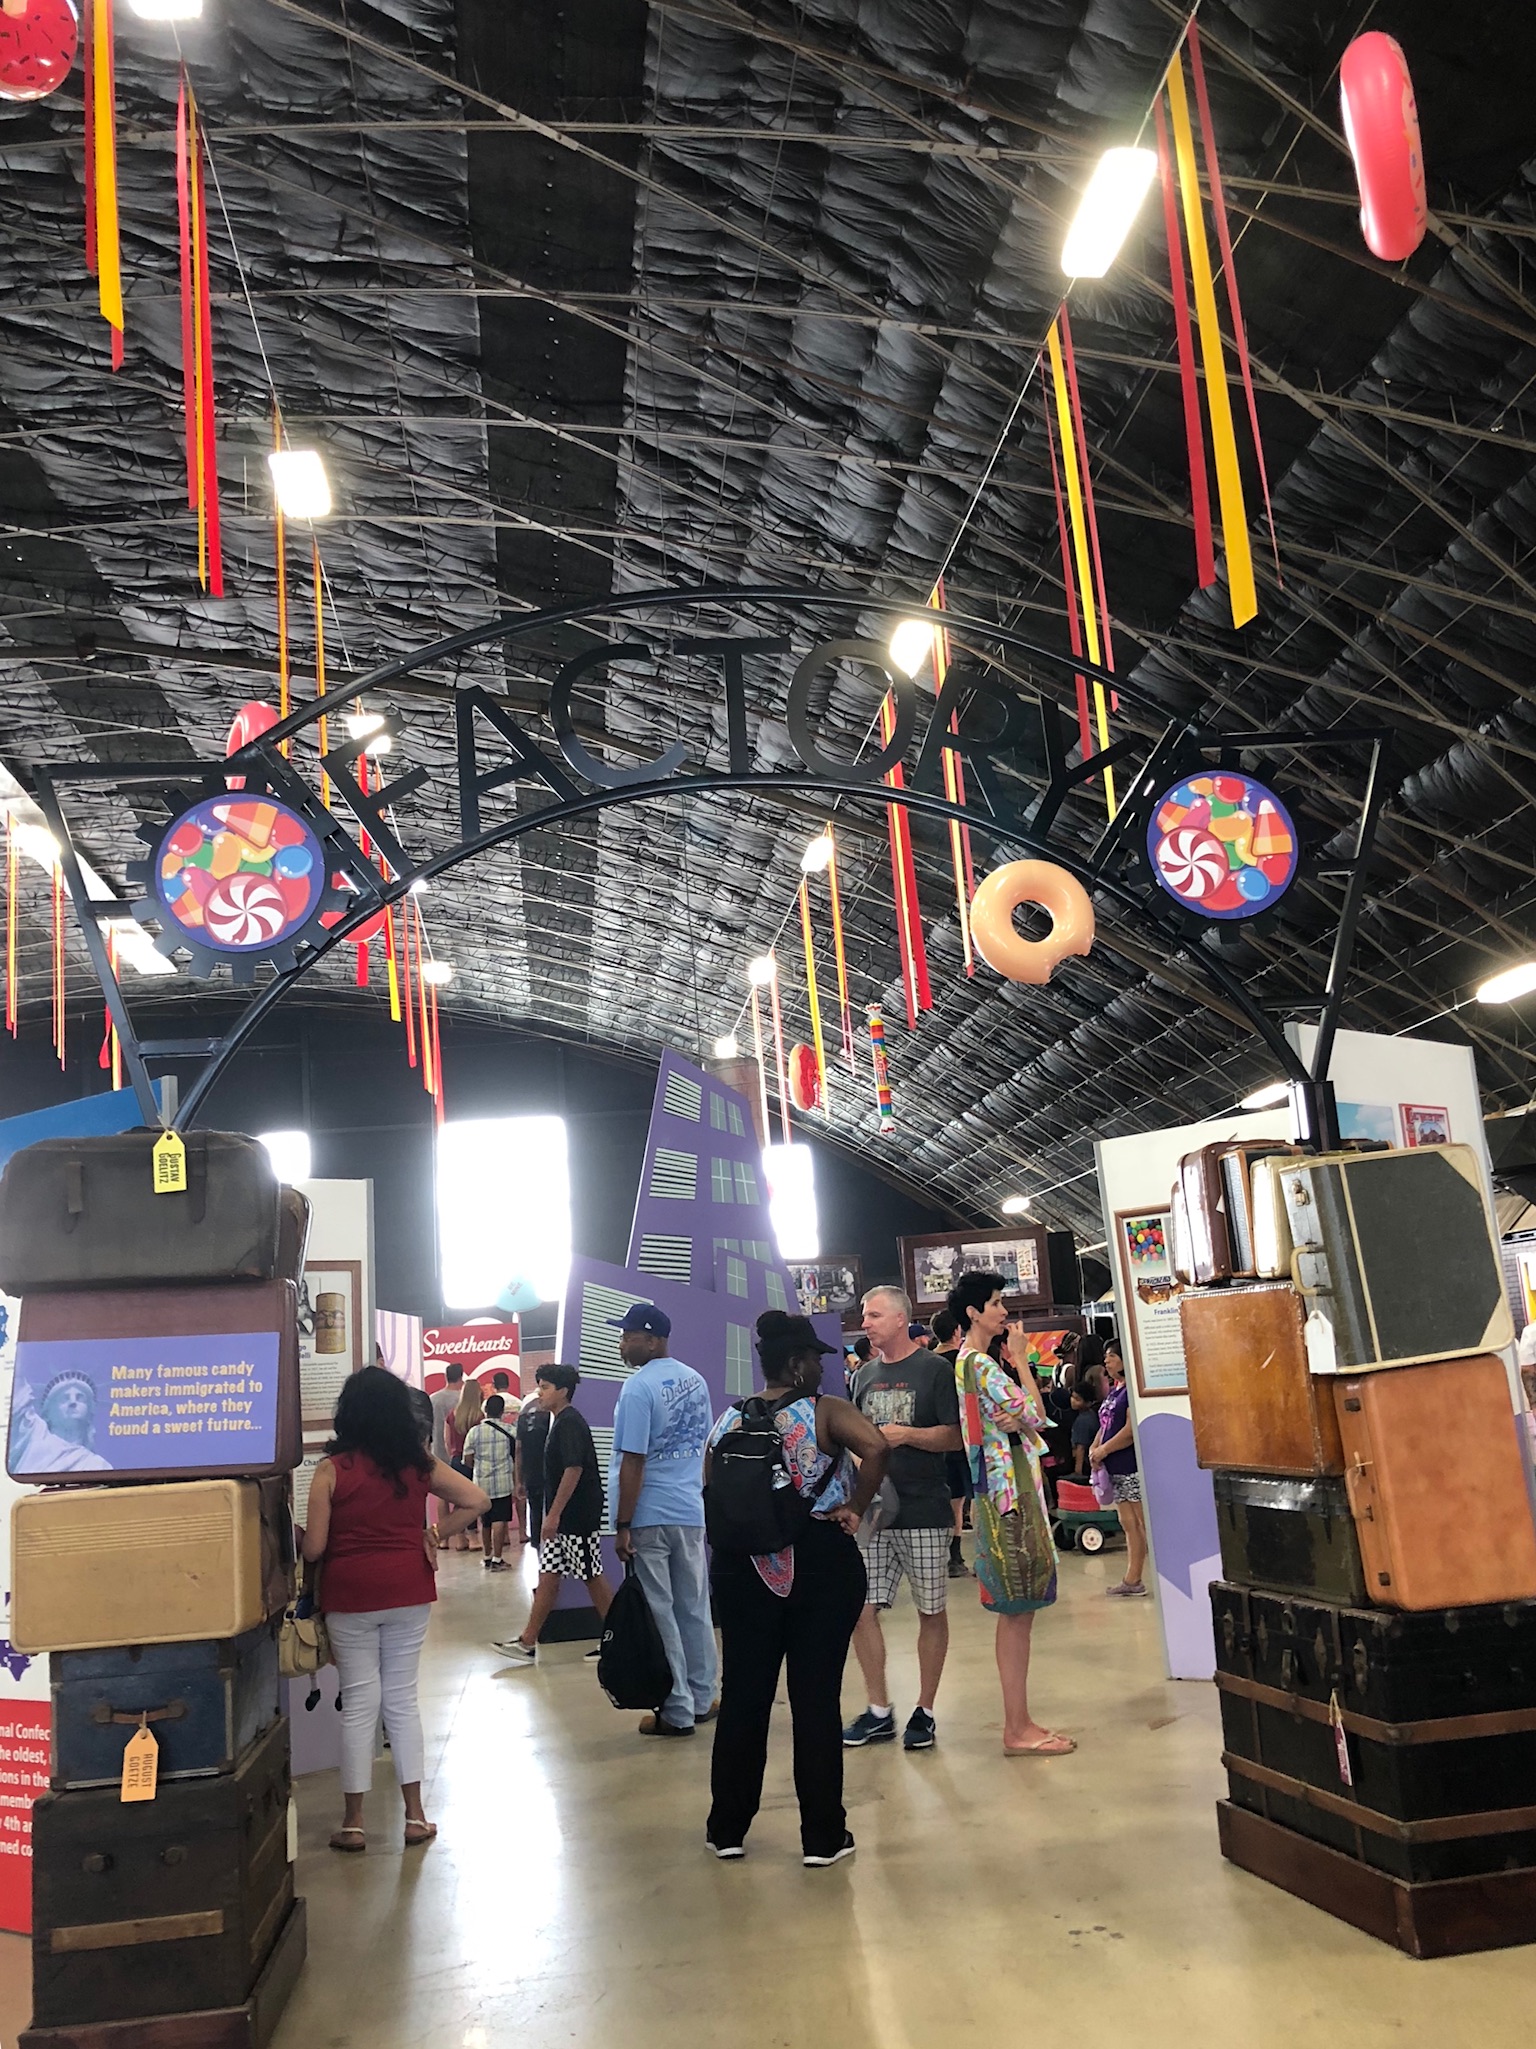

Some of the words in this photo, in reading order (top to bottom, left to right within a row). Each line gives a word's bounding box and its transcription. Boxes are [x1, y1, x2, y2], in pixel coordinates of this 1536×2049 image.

[320, 636, 1152, 878] FACTORY
[423, 1329, 513, 1357] Sweethearts
[111, 1365, 153, 1381] Many
[157, 1364, 208, 1378] famous
[211, 1361, 255, 1377] candy
[110, 1383, 161, 1398] makers
[165, 1379, 245, 1397] immigrated
[249, 1380, 263, 1393] to
[109, 1402, 172, 1417] America,
[176, 1400, 217, 1414] where
[221, 1398, 253, 1414] they
[108, 1420, 149, 1436] found
[152, 1423, 161, 1434] a
[164, 1419, 203, 1433] sweet
[207, 1417, 262, 1432] future...
[15, 1723, 51, 1741] Confec
[13, 1745, 47, 1766] oldest,
[20, 1769, 31, 1786] in
[32, 1770, 50, 1788] the
[141, 1753, 154, 1787] AUGUST
[4, 1815, 21, 1832] 4th
